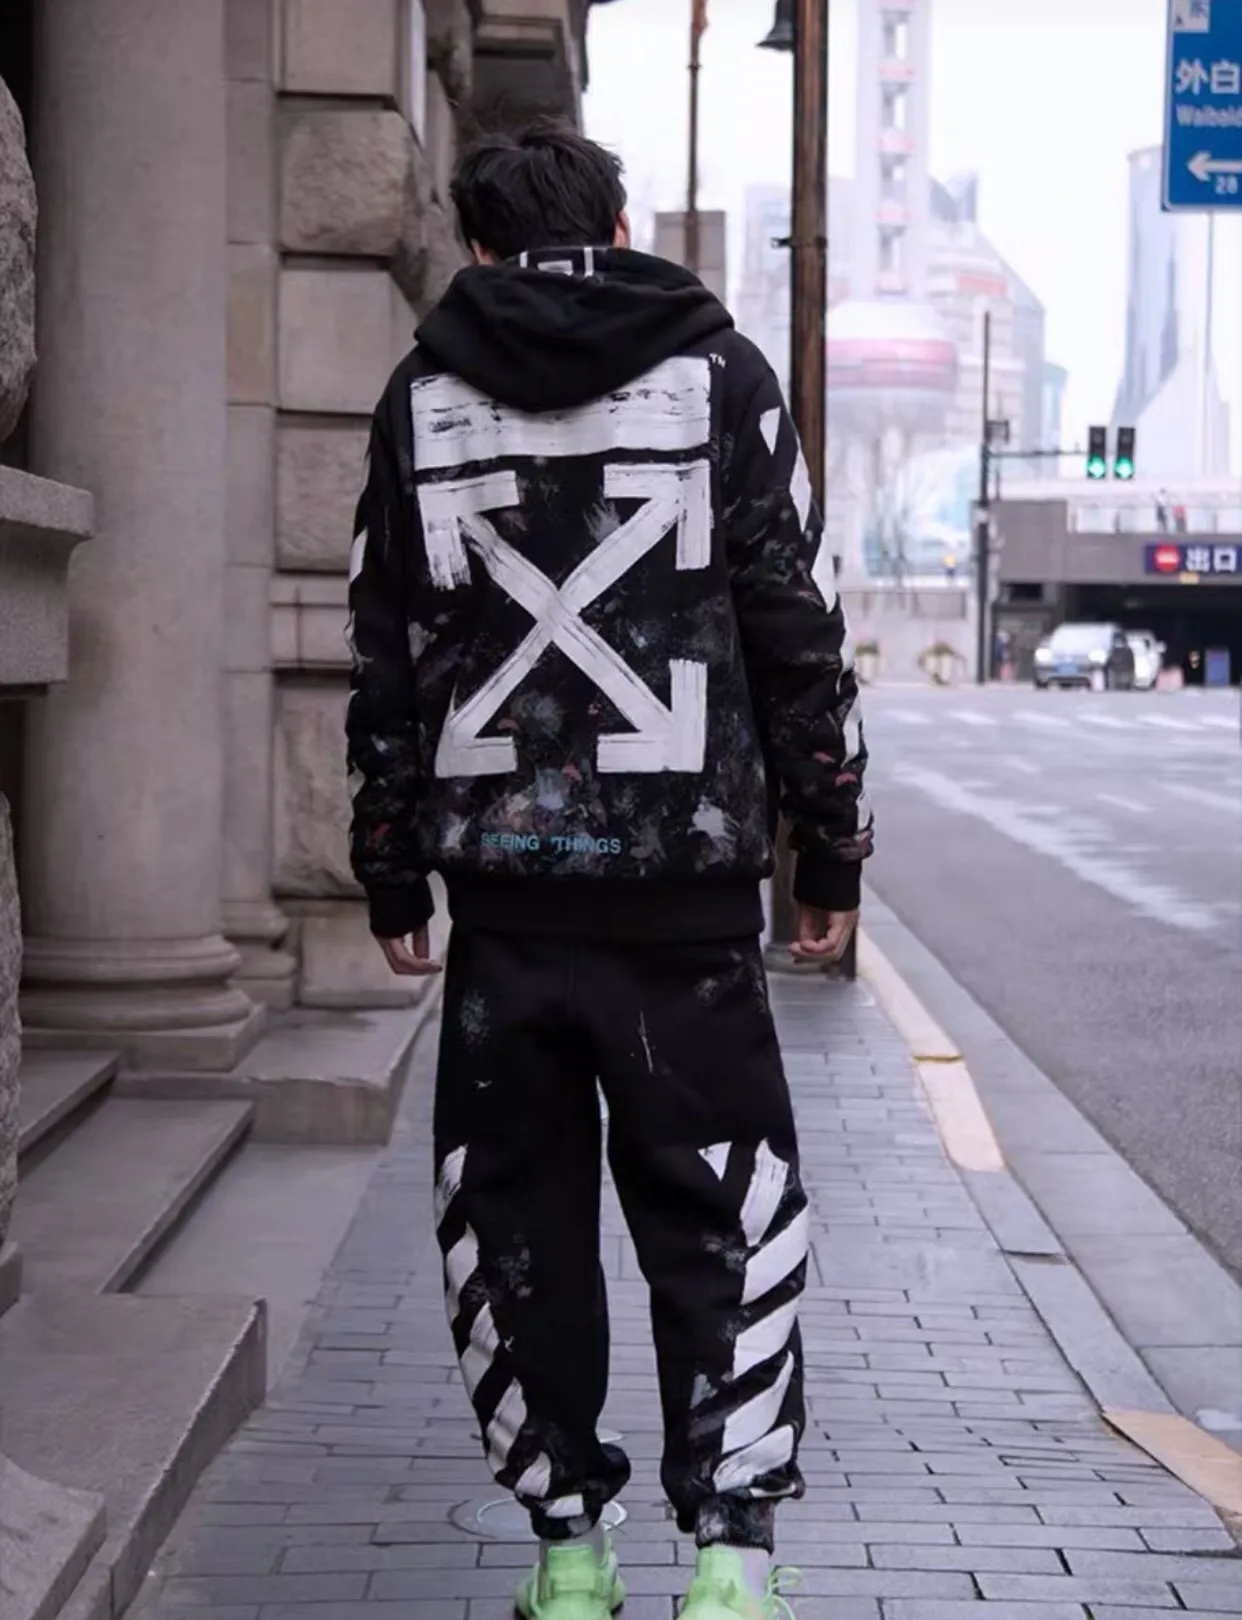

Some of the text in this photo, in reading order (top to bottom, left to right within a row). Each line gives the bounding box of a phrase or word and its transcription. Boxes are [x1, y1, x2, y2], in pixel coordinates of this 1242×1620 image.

[1174, 57, 1241, 95] 外白
[1186, 546, 1237, 572] 出口
[481, 832, 622, 854] SEEING THINGS
